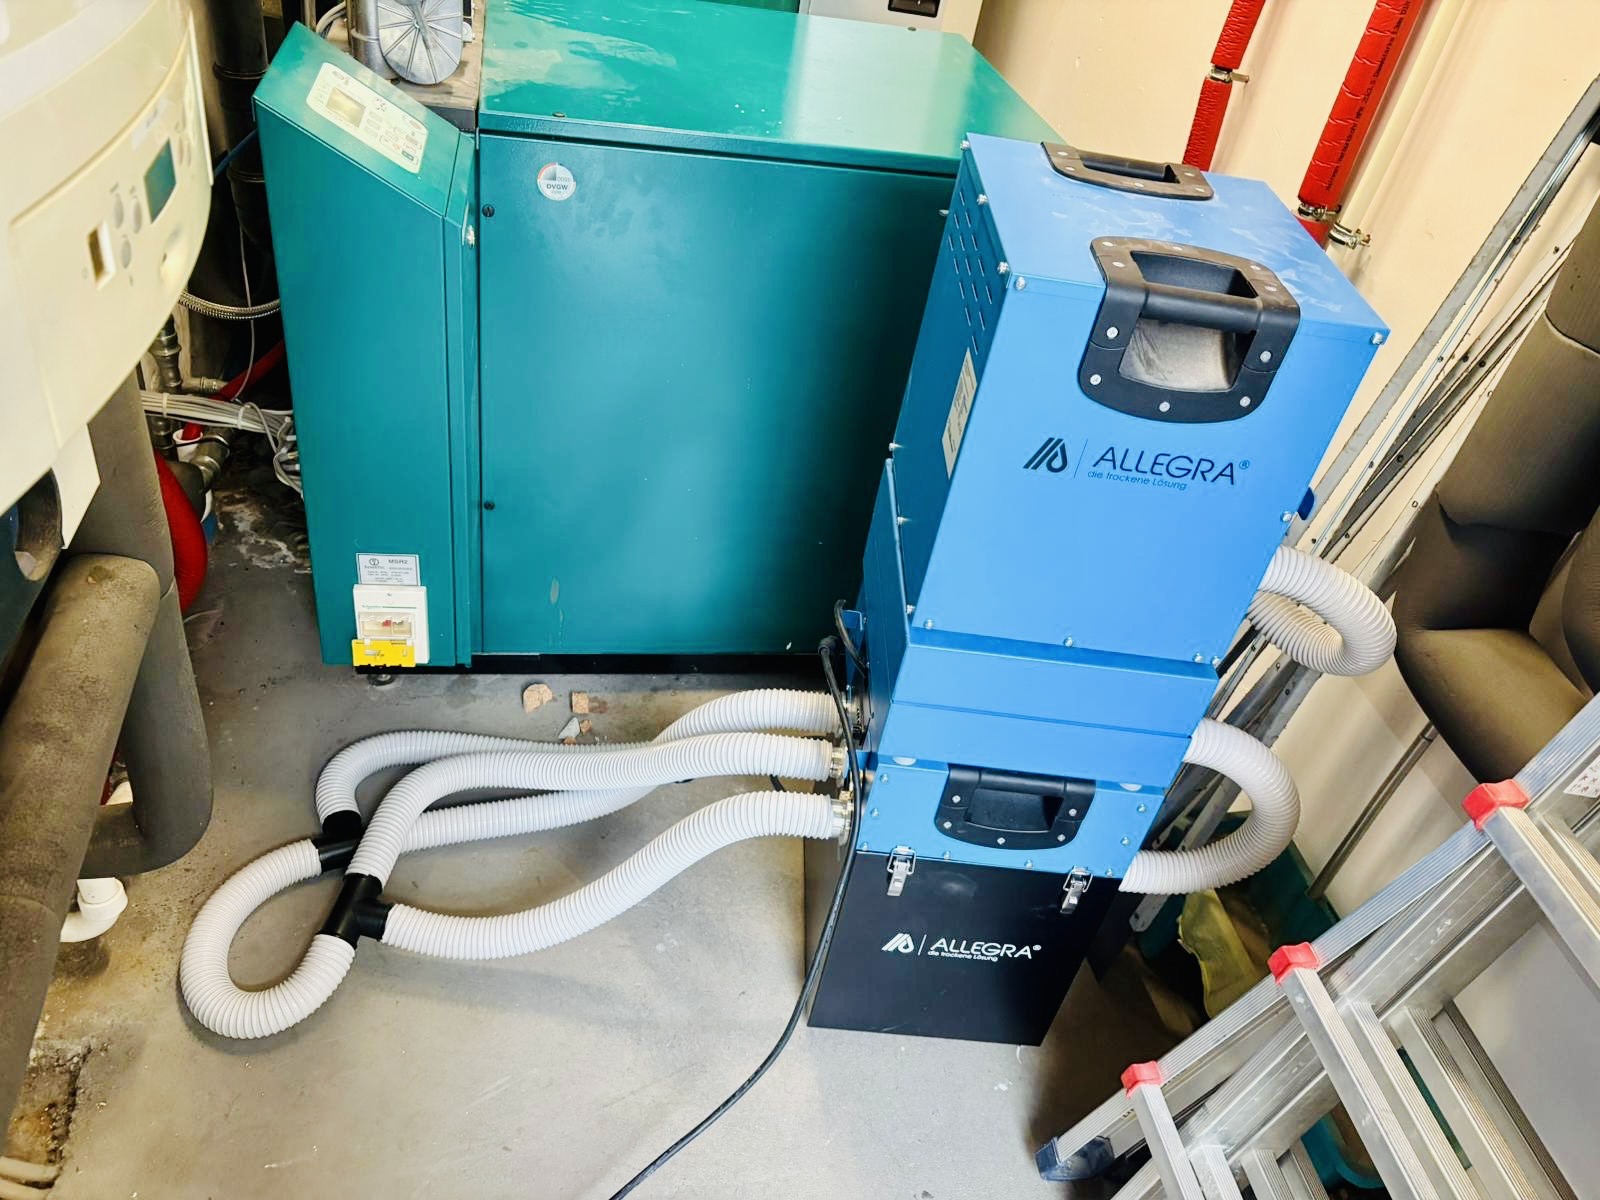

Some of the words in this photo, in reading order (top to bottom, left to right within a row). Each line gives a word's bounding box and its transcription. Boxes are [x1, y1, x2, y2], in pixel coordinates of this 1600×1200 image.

[1087, 470, 1104, 480] die
[1106, 472, 1151, 486] trockene
[1152, 478, 1188, 491] Lösung
[941, 951, 972, 960] trockene
[973, 954, 998, 962] Lösung
